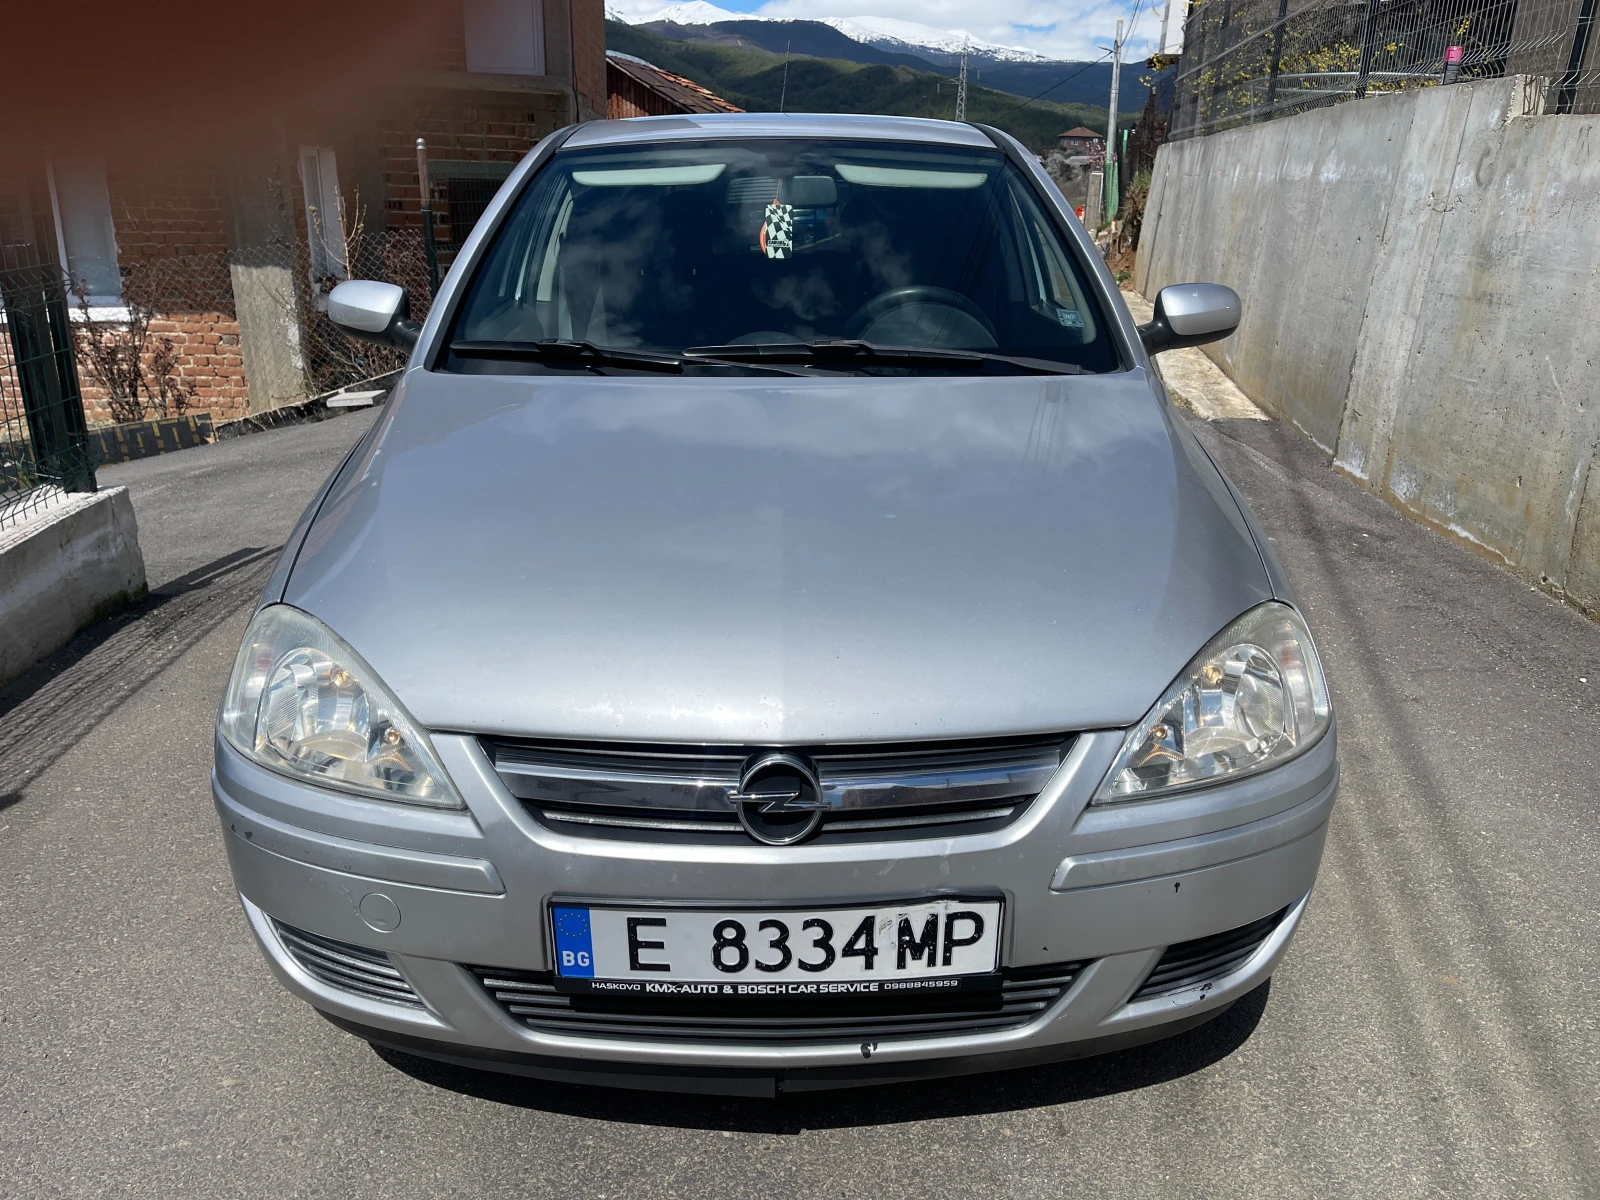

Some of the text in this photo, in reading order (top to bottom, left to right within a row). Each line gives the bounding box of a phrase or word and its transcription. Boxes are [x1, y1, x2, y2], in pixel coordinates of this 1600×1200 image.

[627, 910, 984, 974] E 8334 MP
[562, 951, 590, 967] BG
[591, 982, 641, 991] HASKOVO
[645, 983, 718, 994] KMX-AUTO
[722, 984, 734, 994] &
[738, 985, 786, 995] BOSCH
[788, 984, 818, 994] CAR
[819, 983, 879, 993] SERVICE
